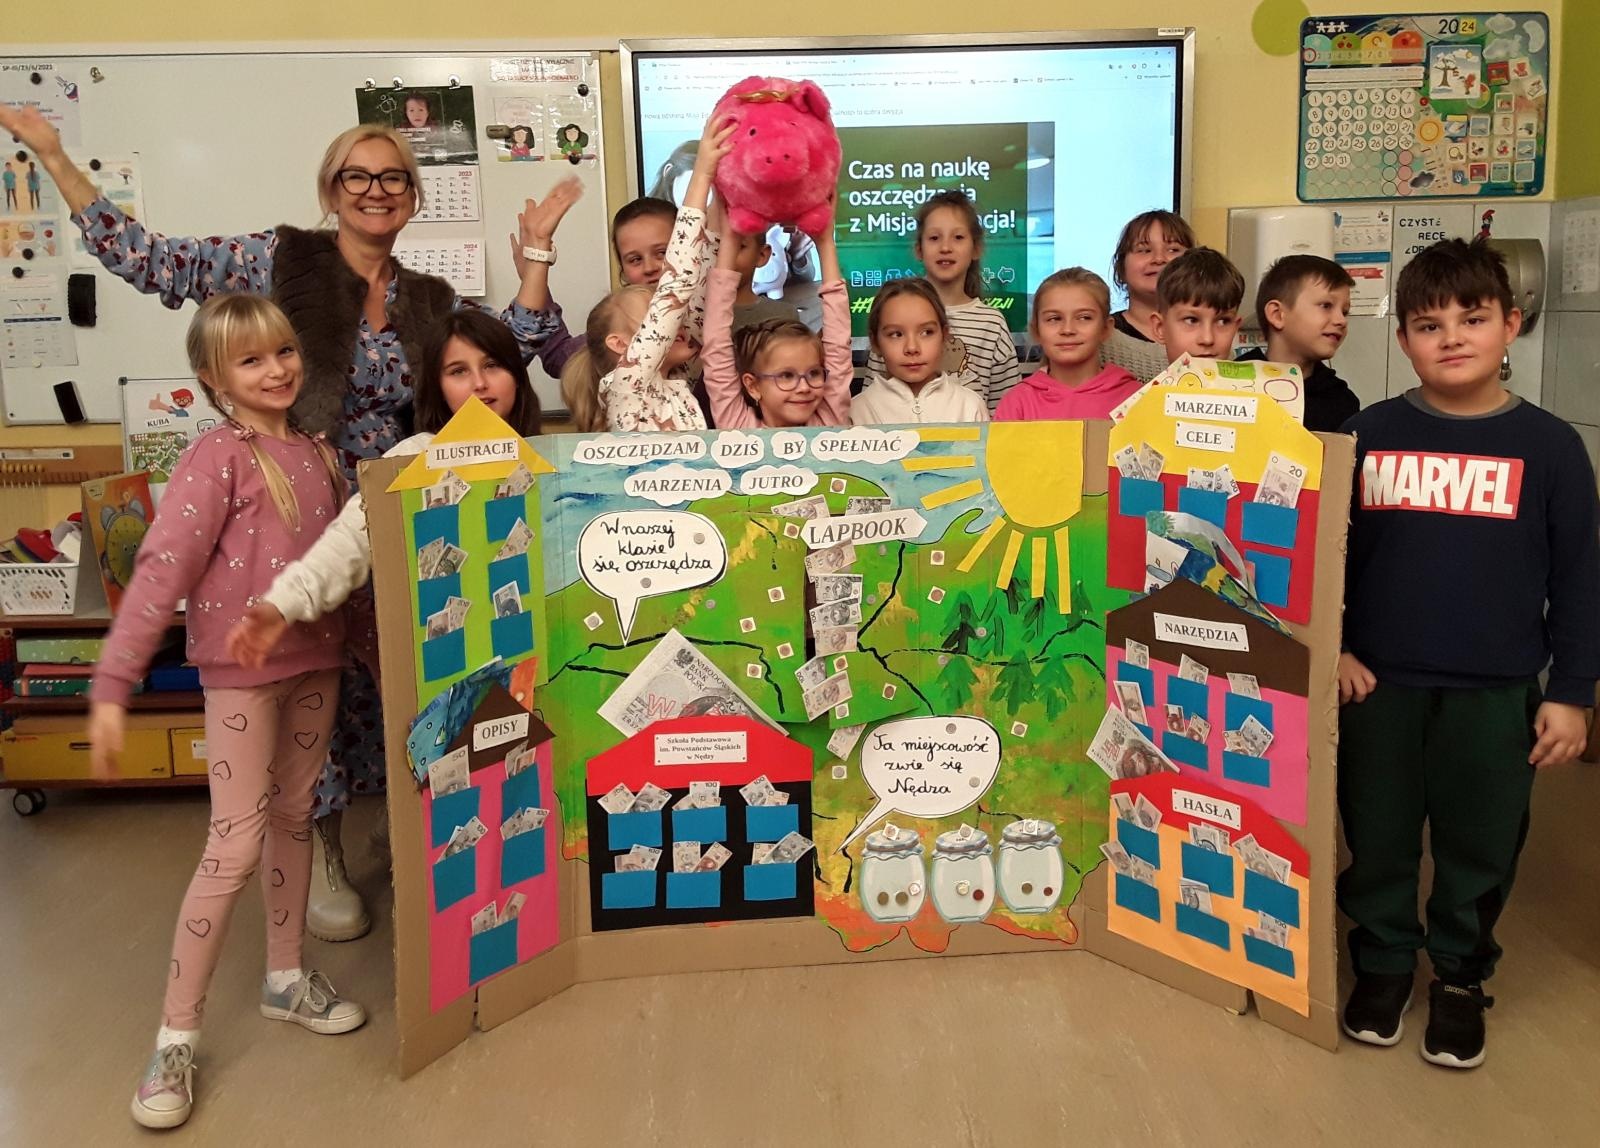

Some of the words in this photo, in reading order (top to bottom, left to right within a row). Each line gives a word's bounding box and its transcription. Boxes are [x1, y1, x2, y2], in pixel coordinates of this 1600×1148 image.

[848, 160, 894, 179] Czas
[901, 163, 924, 178] na
[931, 156, 990, 180] naukę
[850, 218, 861, 232] z
[1174, 400, 1248, 418] MARZENIA
[147, 417, 170, 428] KUBA
[1186, 430, 1222, 445] CELE
[436, 442, 514, 460] ILUSTRACJE
[583, 441, 700, 460] OSZCZĘDZAM
[721, 440, 759, 458] DZIŚ
[784, 440, 804, 454] BY
[819, 436, 902, 452] SPEŁNIAĆ
[1288, 465, 1303, 478] 20
[632, 477, 722, 493] MARZENIA
[750, 475, 804, 491] JUTRO
[1362, 455, 1514, 514] MARVEL
[622, 518, 676, 548] naszej
[809, 517, 908, 546] LAPBOOK
[618, 539, 666, 557] klasie
[592, 558, 621, 574] się
[626, 556, 713, 575] oszczędza
[1164, 622, 1240, 642] NARZĘDZIA
[482, 720, 519, 740] OPISY
[672, 744, 712, 752] Powstańców
[714, 742, 742, 751] Śląskich
[690, 736, 732, 744] Podstawowa
[901, 736, 990, 762] miejscowość
[452, 750, 466, 762] 50
[694, 752, 714, 762] Nędzy
[884, 760, 925, 771] zwie
[940, 759, 964, 774] się
[888, 778, 952, 796] Nędza
[1183, 798, 1233, 820] HASŁA
